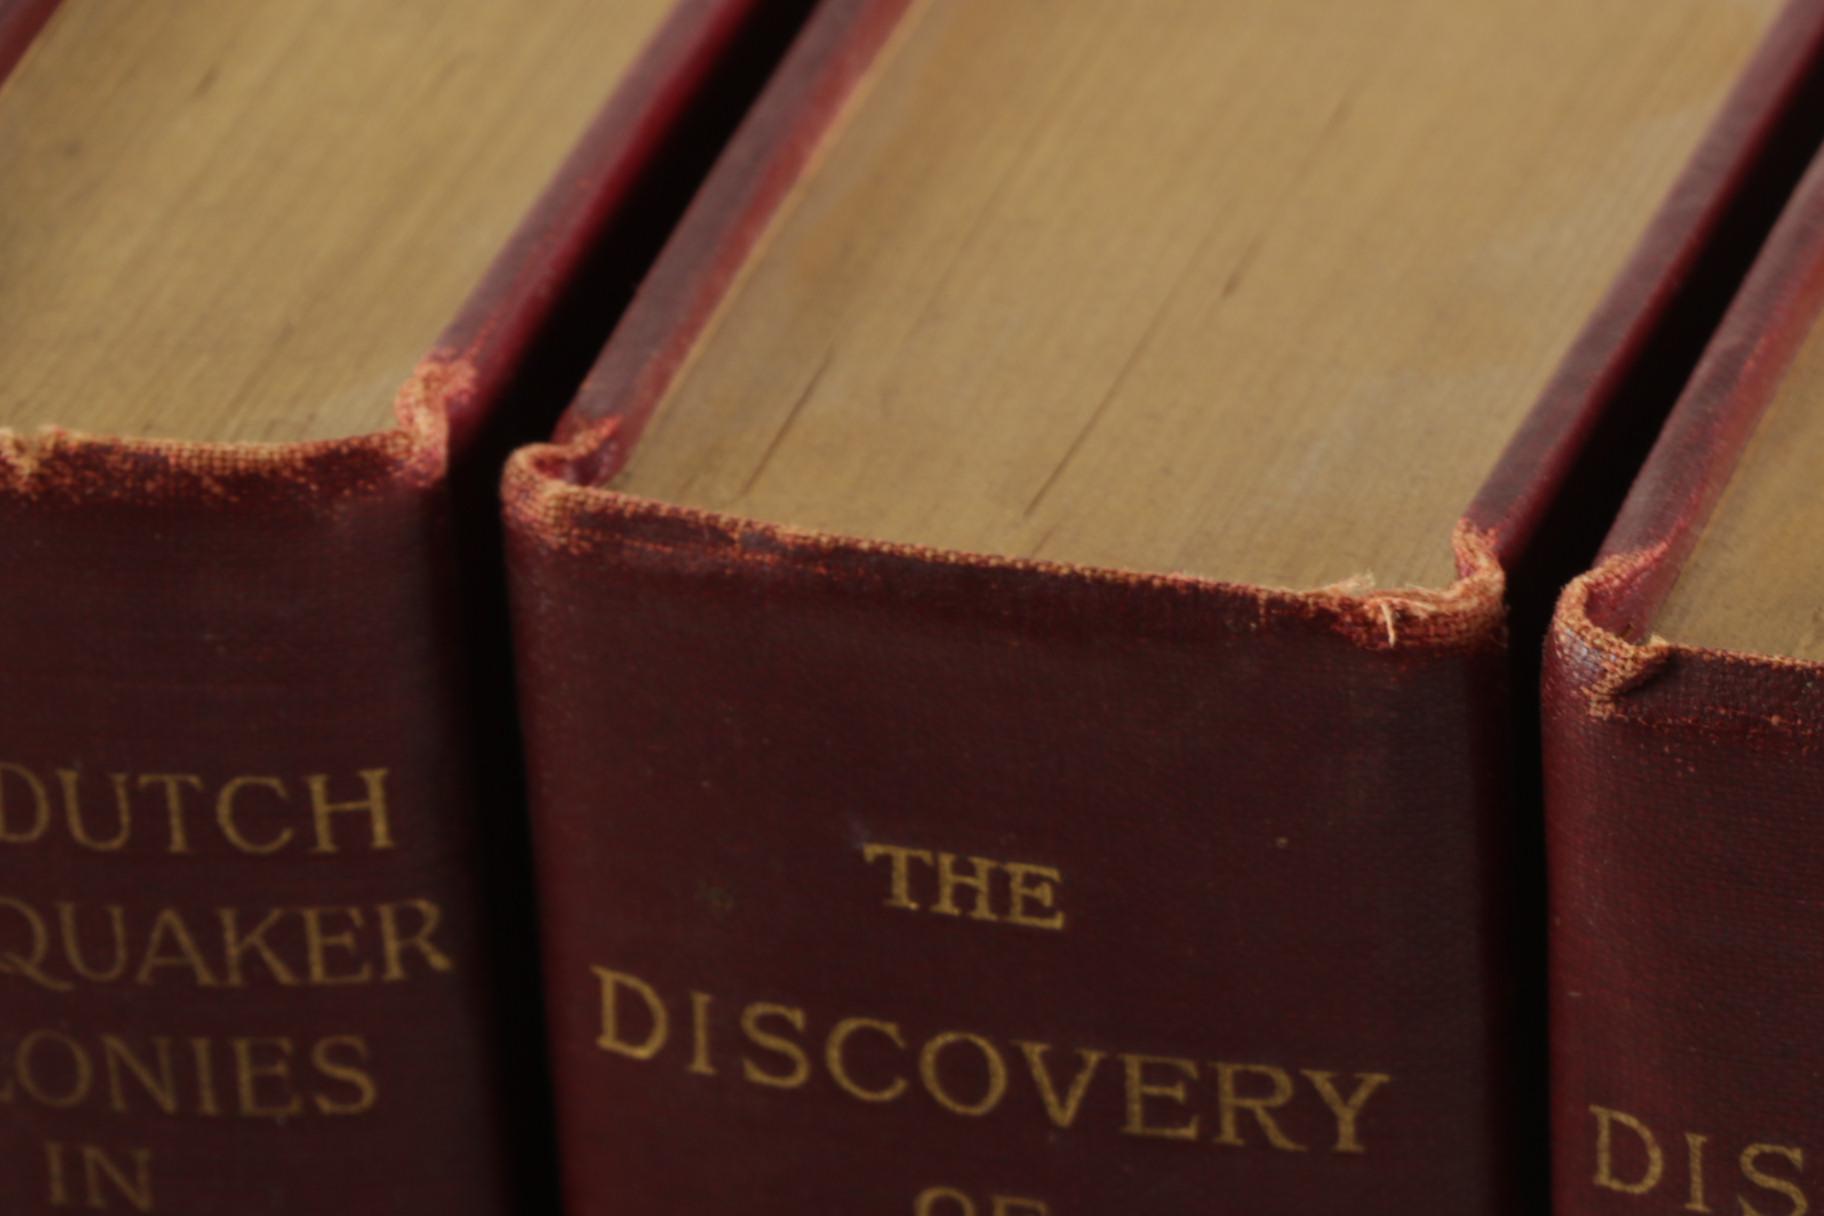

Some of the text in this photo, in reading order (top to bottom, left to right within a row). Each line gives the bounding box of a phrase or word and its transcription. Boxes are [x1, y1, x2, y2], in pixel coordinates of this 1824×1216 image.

[0, 761, 399, 853] DUTCH
[863, 842, 1066, 930] THE
[0, 897, 456, 990] QUAKER
[0, 1028, 379, 1117] ONIES
[590, 964, 1392, 1155] DISCOVERY
[43, 1140, 155, 1212] IN
